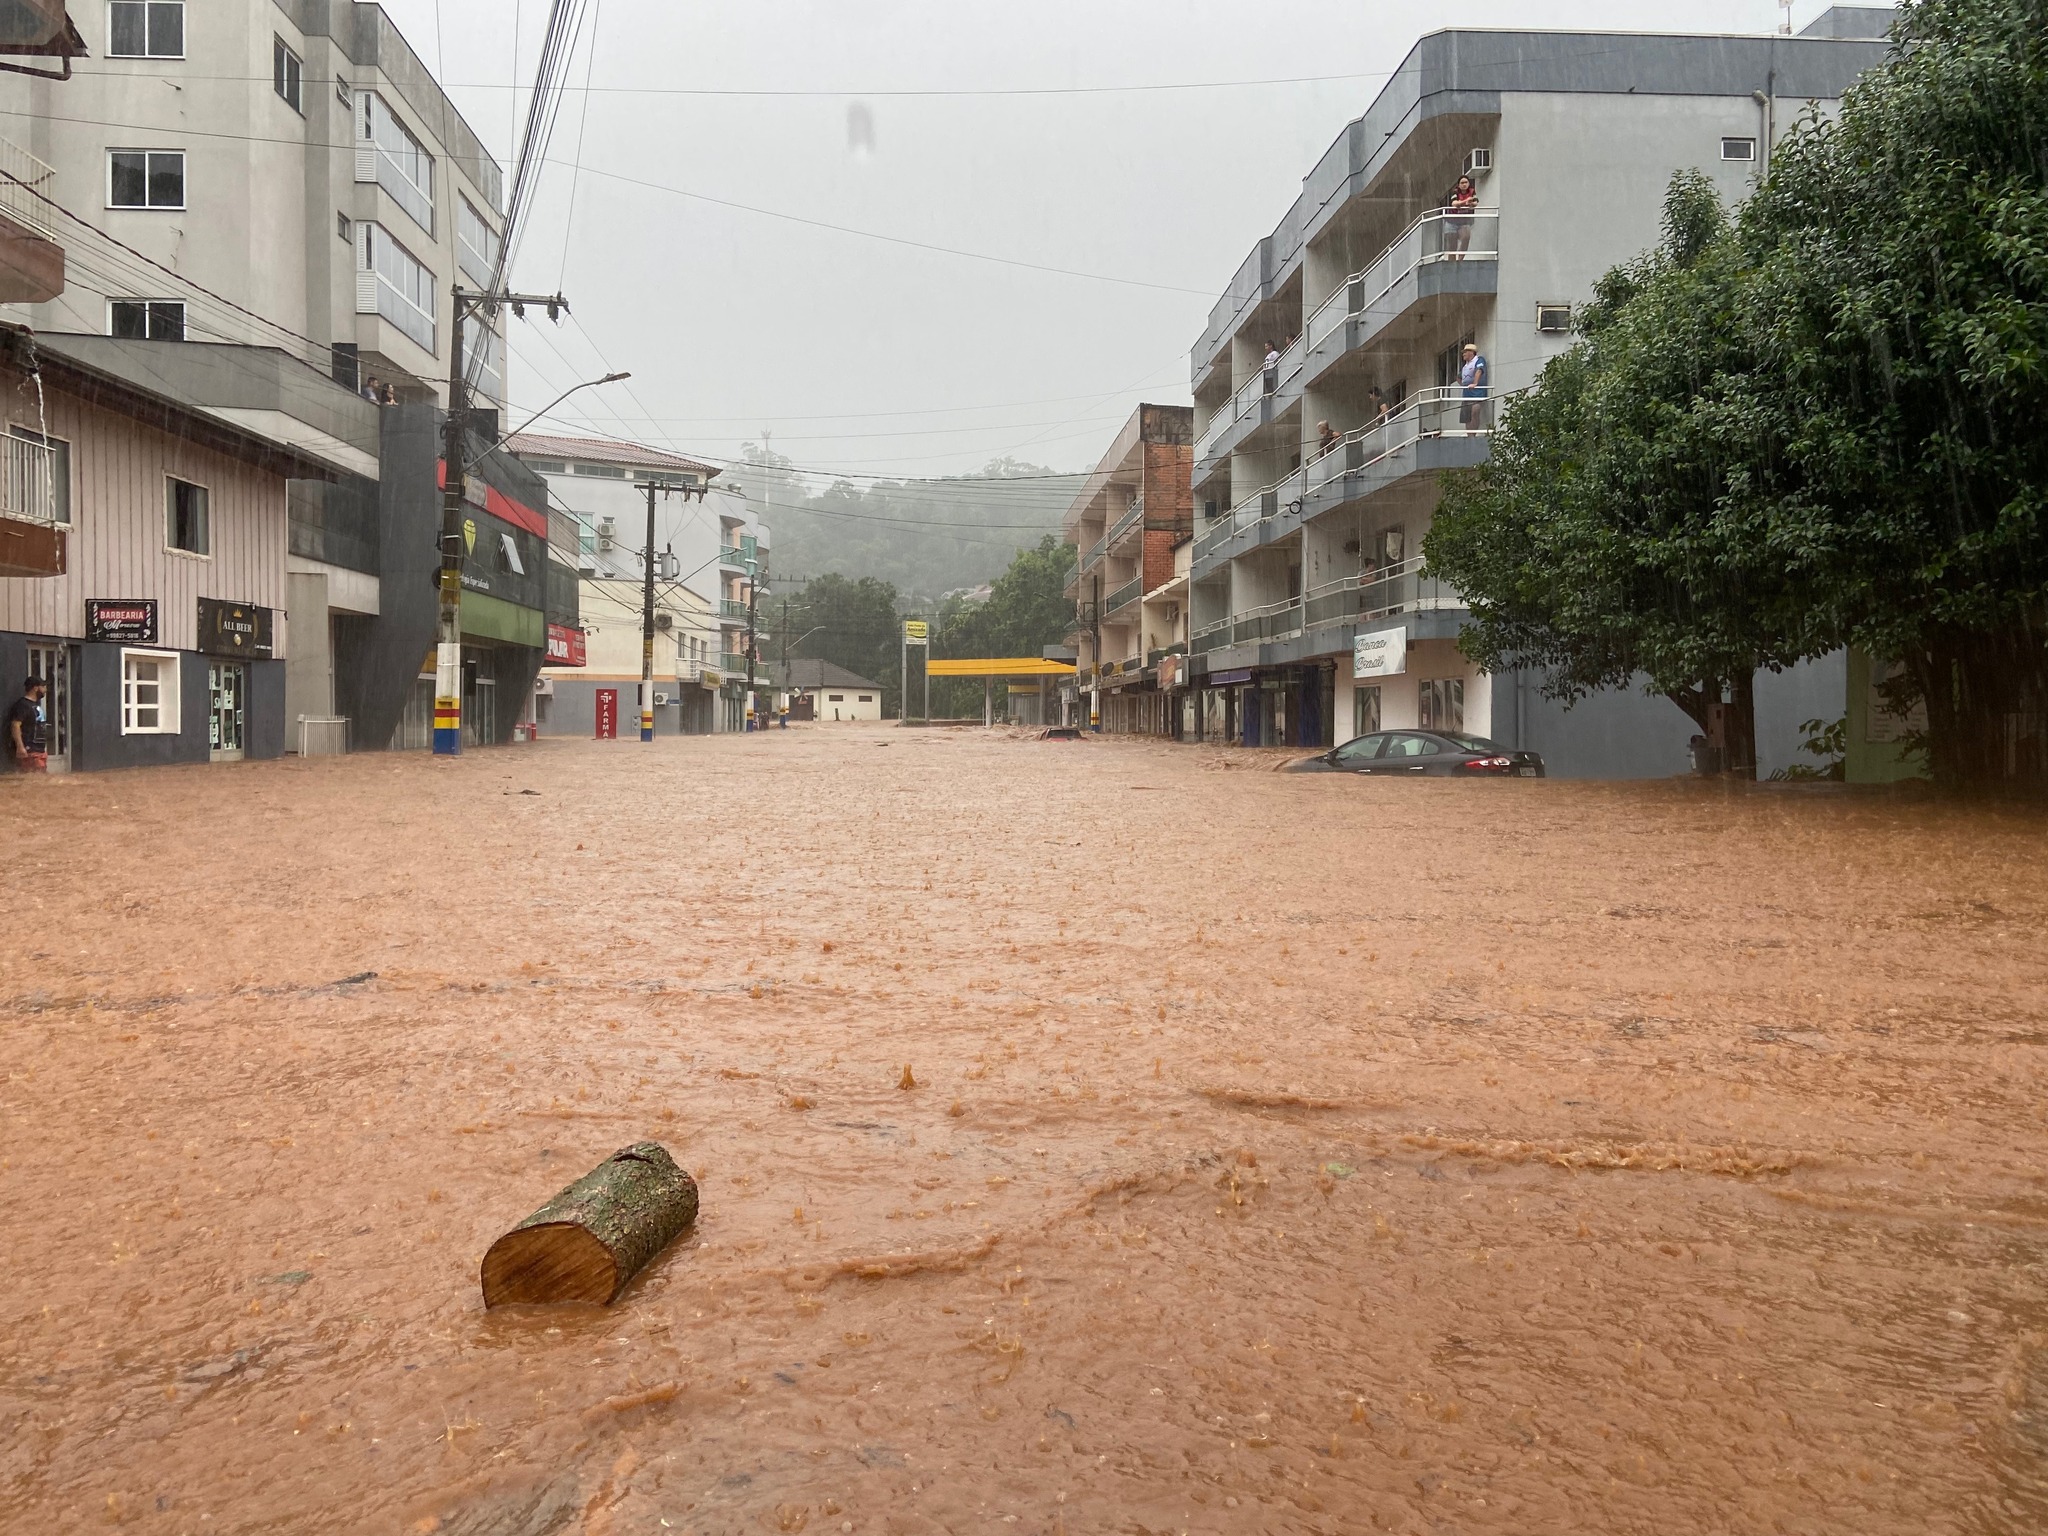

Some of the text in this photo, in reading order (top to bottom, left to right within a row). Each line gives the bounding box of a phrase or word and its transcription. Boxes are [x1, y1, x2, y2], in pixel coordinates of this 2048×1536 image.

[100, 611, 144, 620] BARBEARIA
[223, 621, 252, 633] ALL BEER
